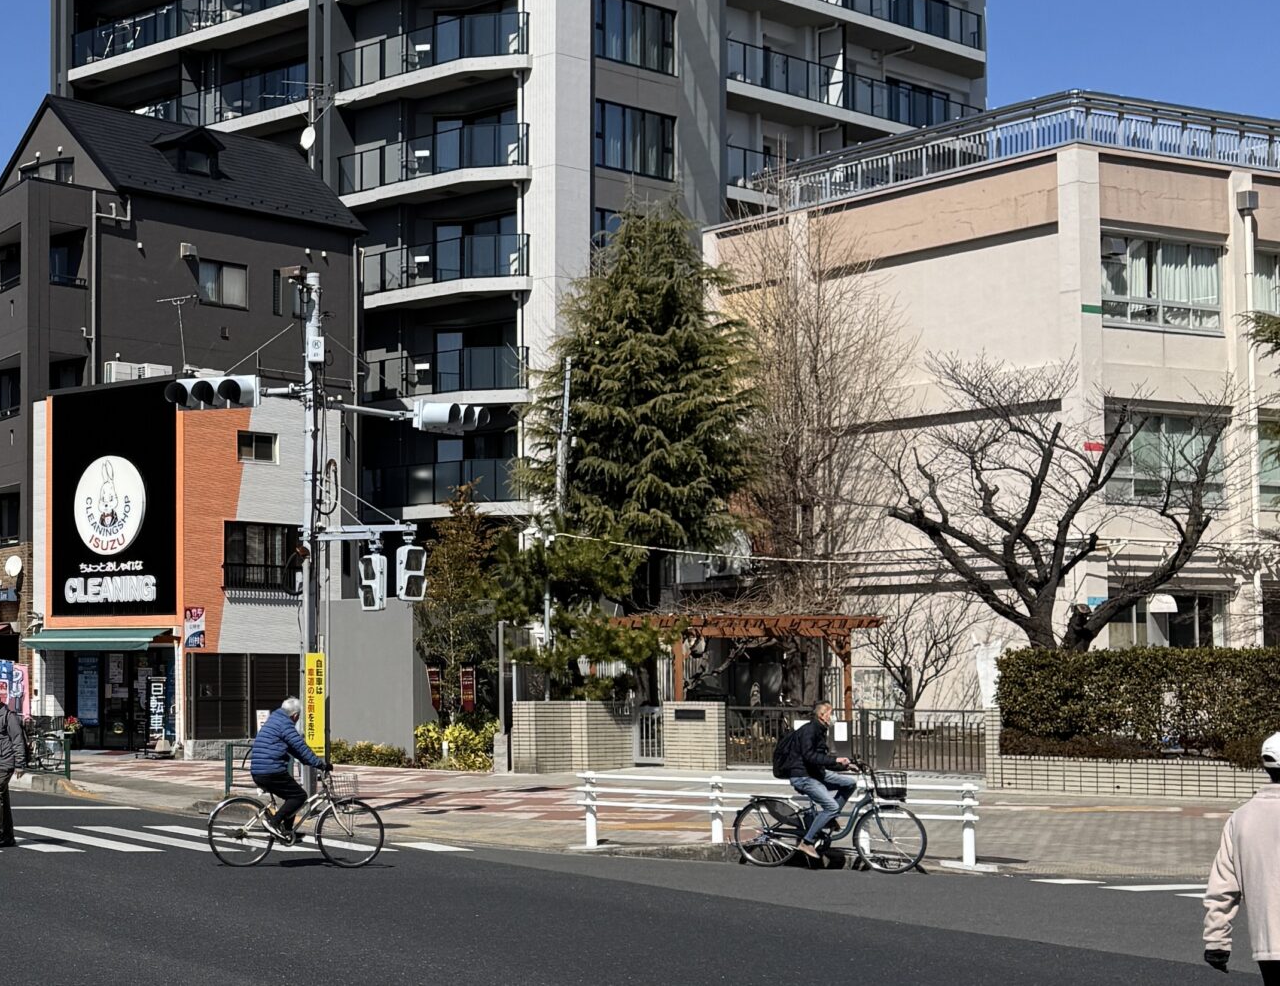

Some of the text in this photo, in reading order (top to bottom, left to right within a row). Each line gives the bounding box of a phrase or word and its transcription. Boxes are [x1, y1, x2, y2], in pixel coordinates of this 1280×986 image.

[88, 534, 126, 551] ISUZU
[79, 560, 143, 574] ちょっとおしゃれな
[64, 574, 157, 604] CLEANING
